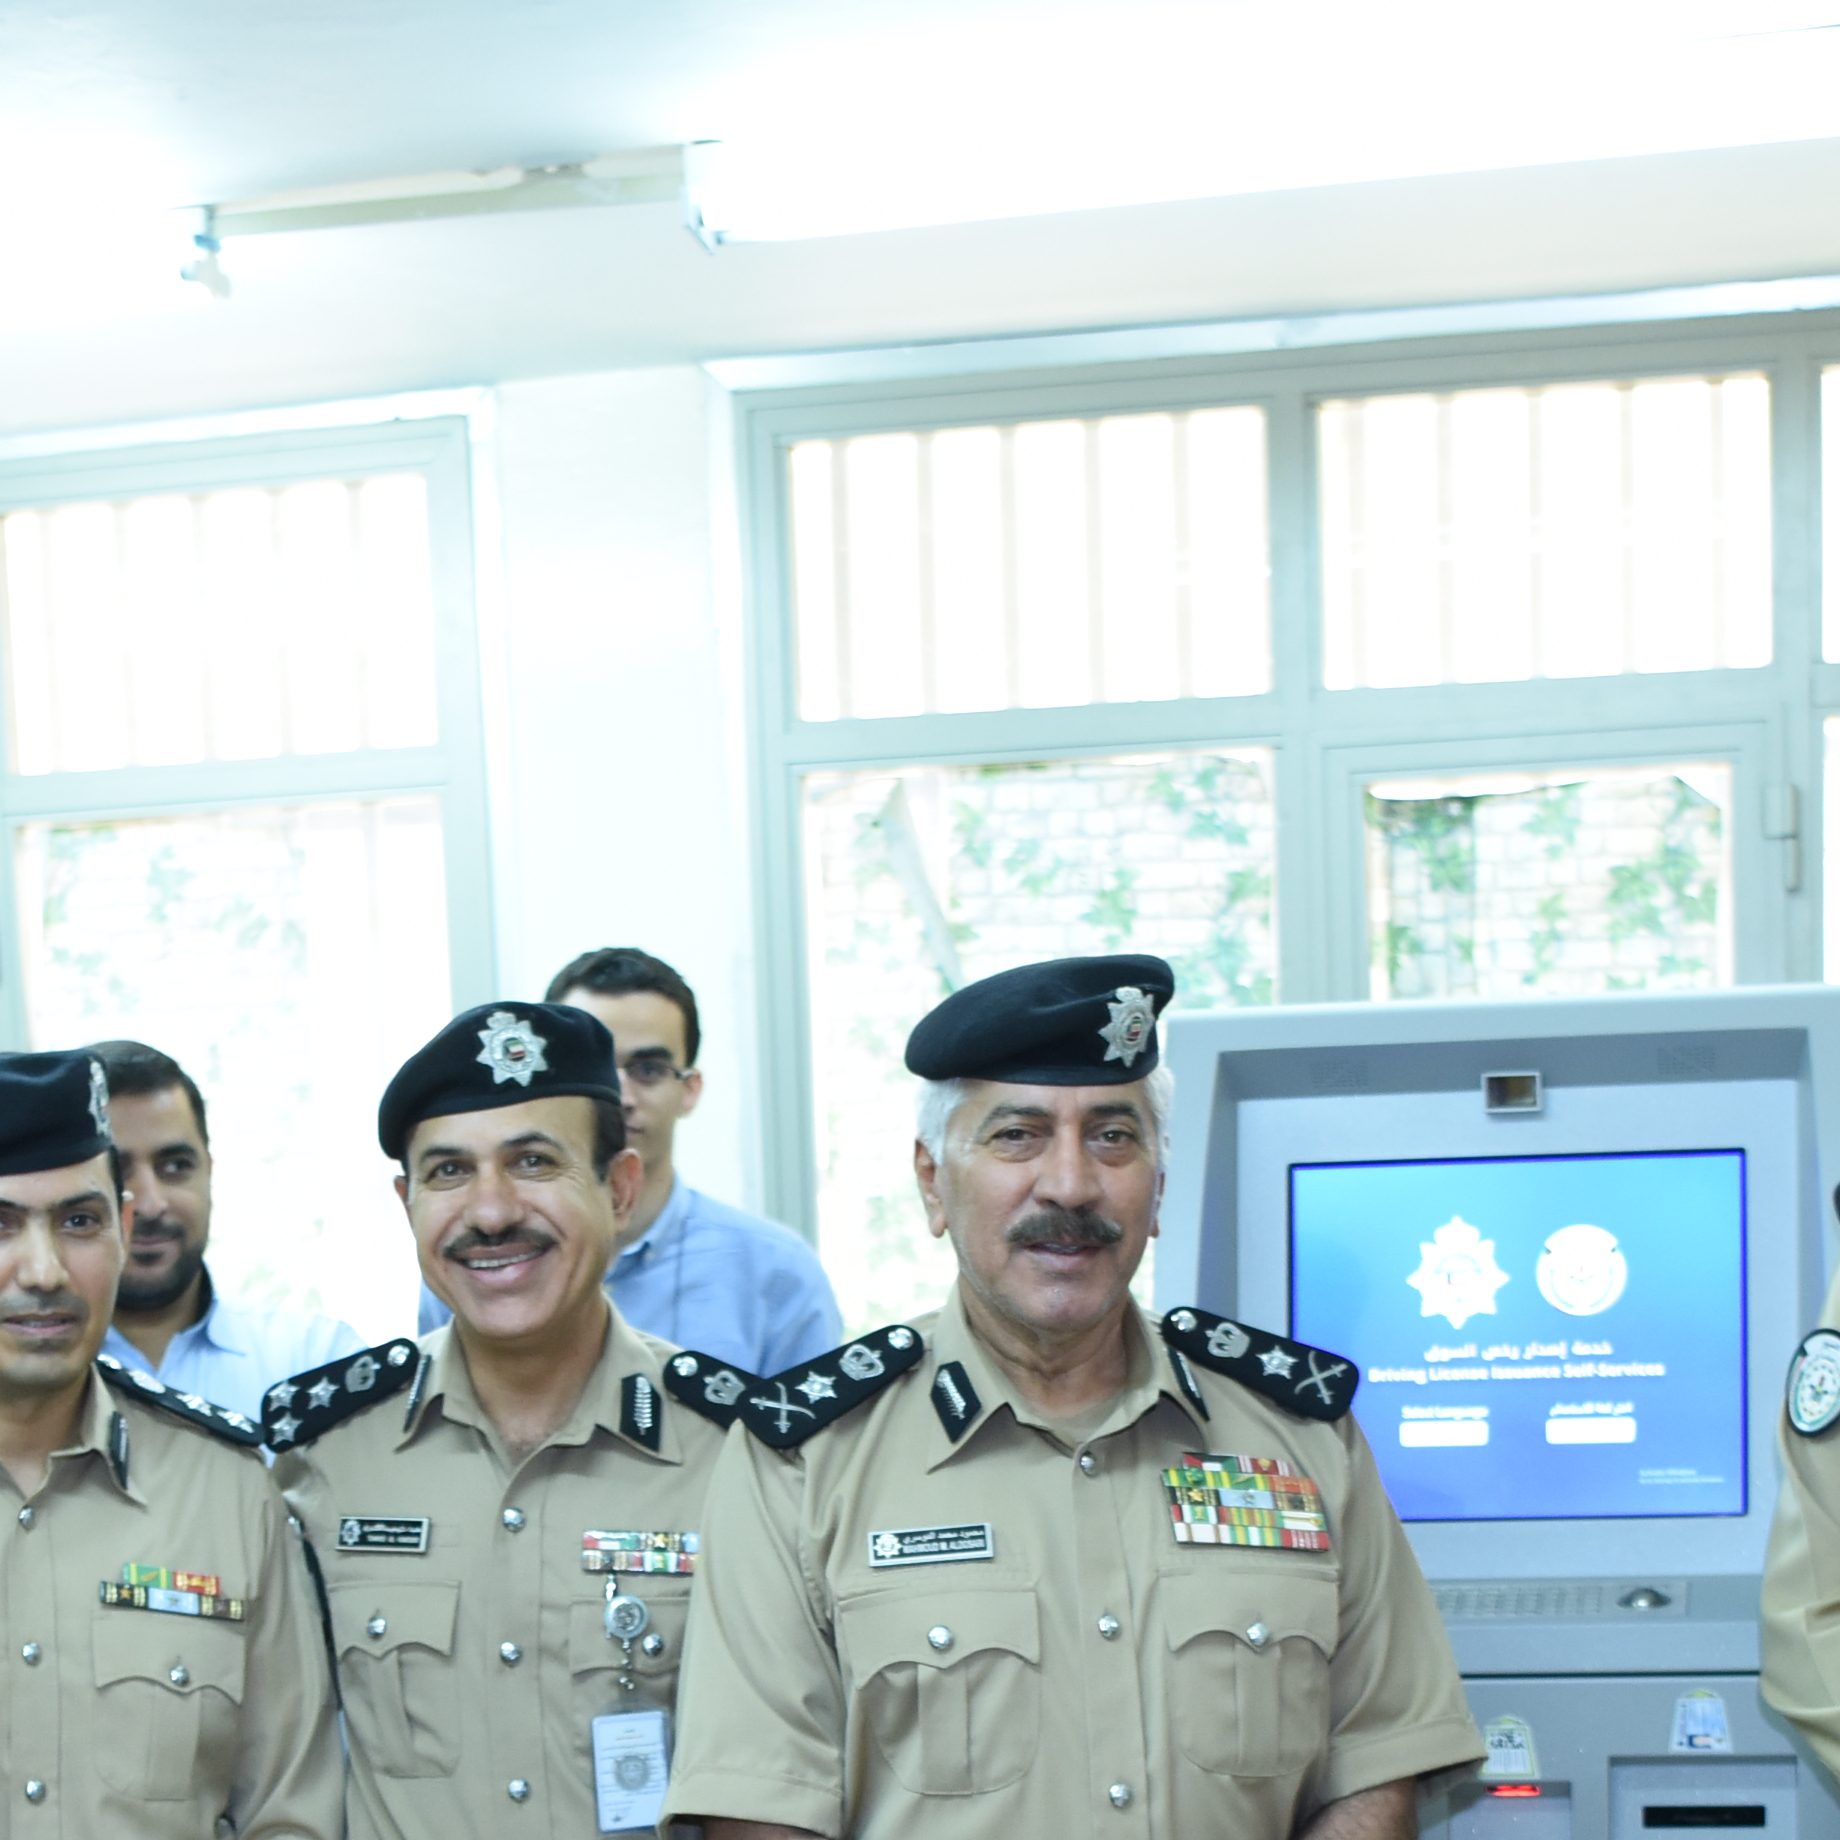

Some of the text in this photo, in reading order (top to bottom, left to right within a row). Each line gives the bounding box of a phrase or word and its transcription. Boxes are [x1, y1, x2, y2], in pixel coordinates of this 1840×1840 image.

[1368, 1362, 1665, 1385] Driving License Issuance Self-Services
